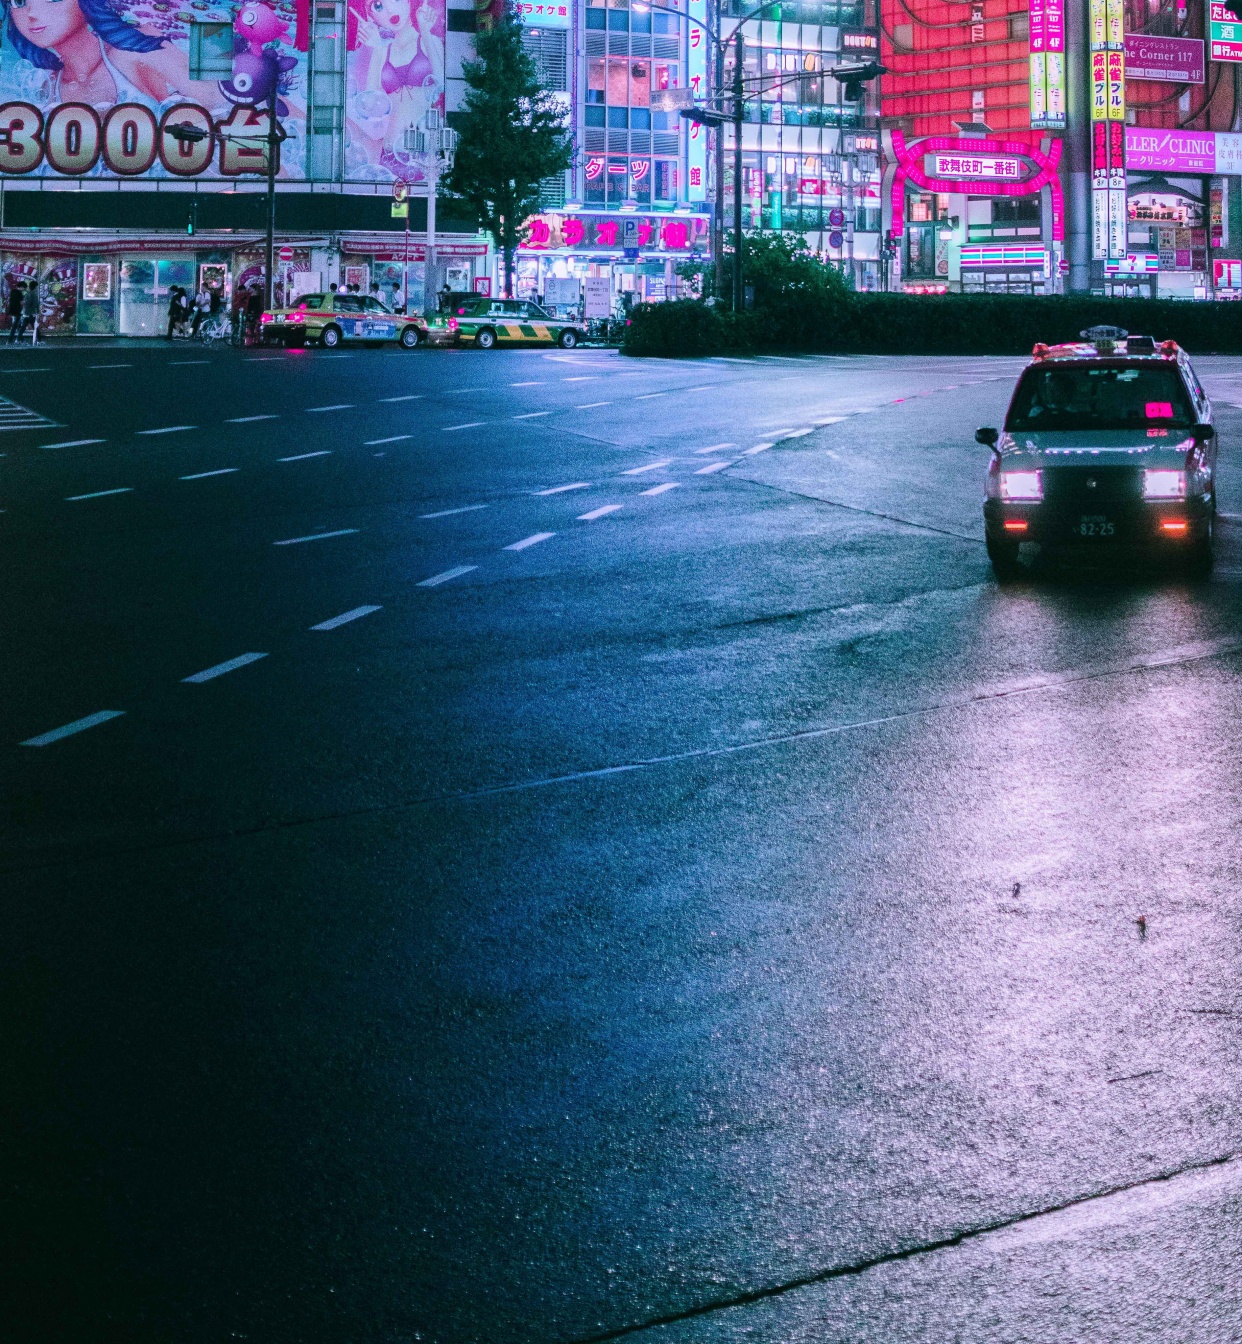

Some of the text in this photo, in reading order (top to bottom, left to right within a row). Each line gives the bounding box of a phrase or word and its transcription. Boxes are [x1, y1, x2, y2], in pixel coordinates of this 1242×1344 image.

[1220, 24, 1235, 39] 酒
[1032, 38, 1043, 48] 4F
[1049, 38, 1061, 48] 4F
[1139, 49, 1175, 61] Corner
[1177, 52, 1193, 62] 117
[1093, 52, 1105, 107] 麻雀ブル
[1108, 52, 1122, 107] 麻雀ブル
[1190, 68, 1201, 80] 4F
[1095, 109, 1104, 117] 6F
[1111, 108, 1121, 118] 6F
[1169, 138, 1215, 155] CLINIC
[585, 157, 650, 181] ダーツ
[938, 158, 1016, 176] 歌舞伎町一番街
[1096, 178, 1105, 187] 8F
[1112, 178, 1122, 187] 8F
[625, 221, 635, 236] P
